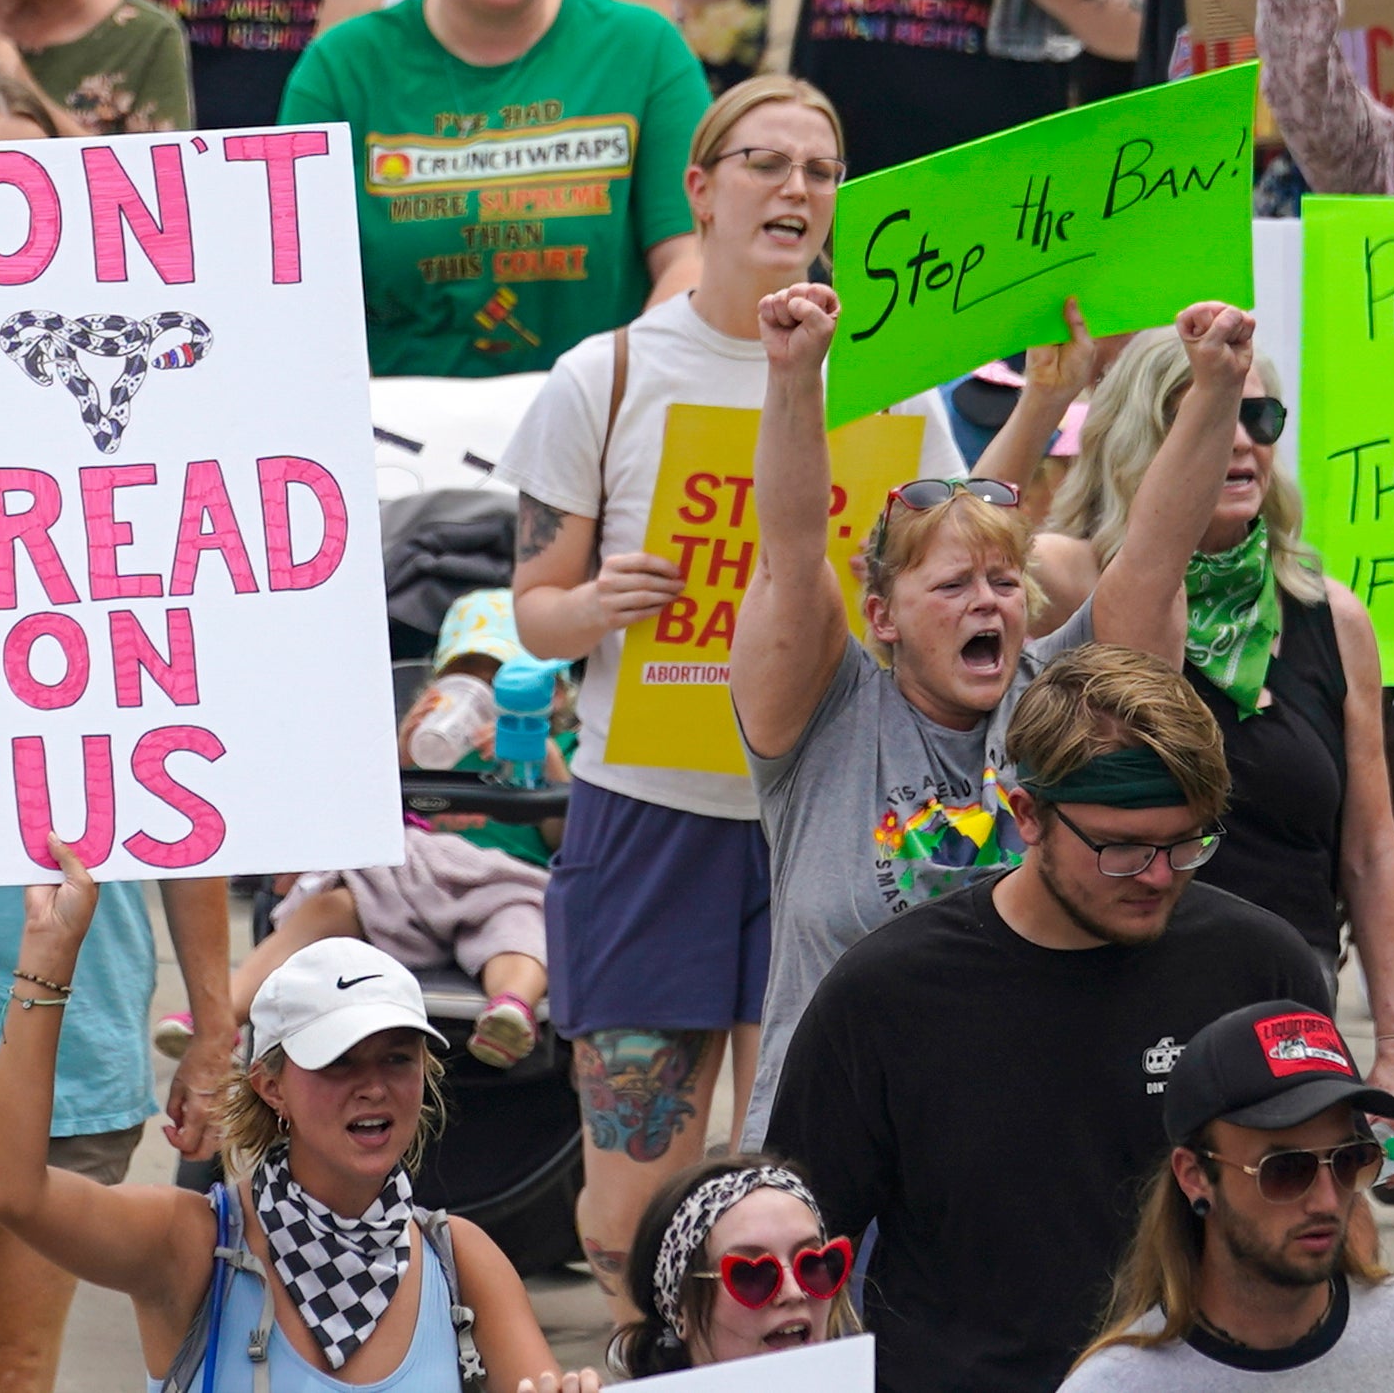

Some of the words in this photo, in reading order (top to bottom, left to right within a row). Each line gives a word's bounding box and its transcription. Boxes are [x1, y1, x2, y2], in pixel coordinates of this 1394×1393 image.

[499, 99, 564, 126] HAD
[414, 134, 627, 176] CRUNCHWRAPS
[389, 193, 468, 223] MORE
[478, 182, 611, 218] SUPREME
[462, 220, 544, 250] THAN
[850, 208, 986, 343] Stop
[1011, 175, 1075, 252] the
[1102, 127, 1247, 220] BAN!
[417, 251, 483, 284] THIS
[492, 244, 589, 280] COURT
[668, 534, 755, 590] TH
[654, 595, 740, 651] BA
[3, 607, 201, 711] ON
[645, 664, 732, 685] ABORTION
[11, 724, 228, 871] US
